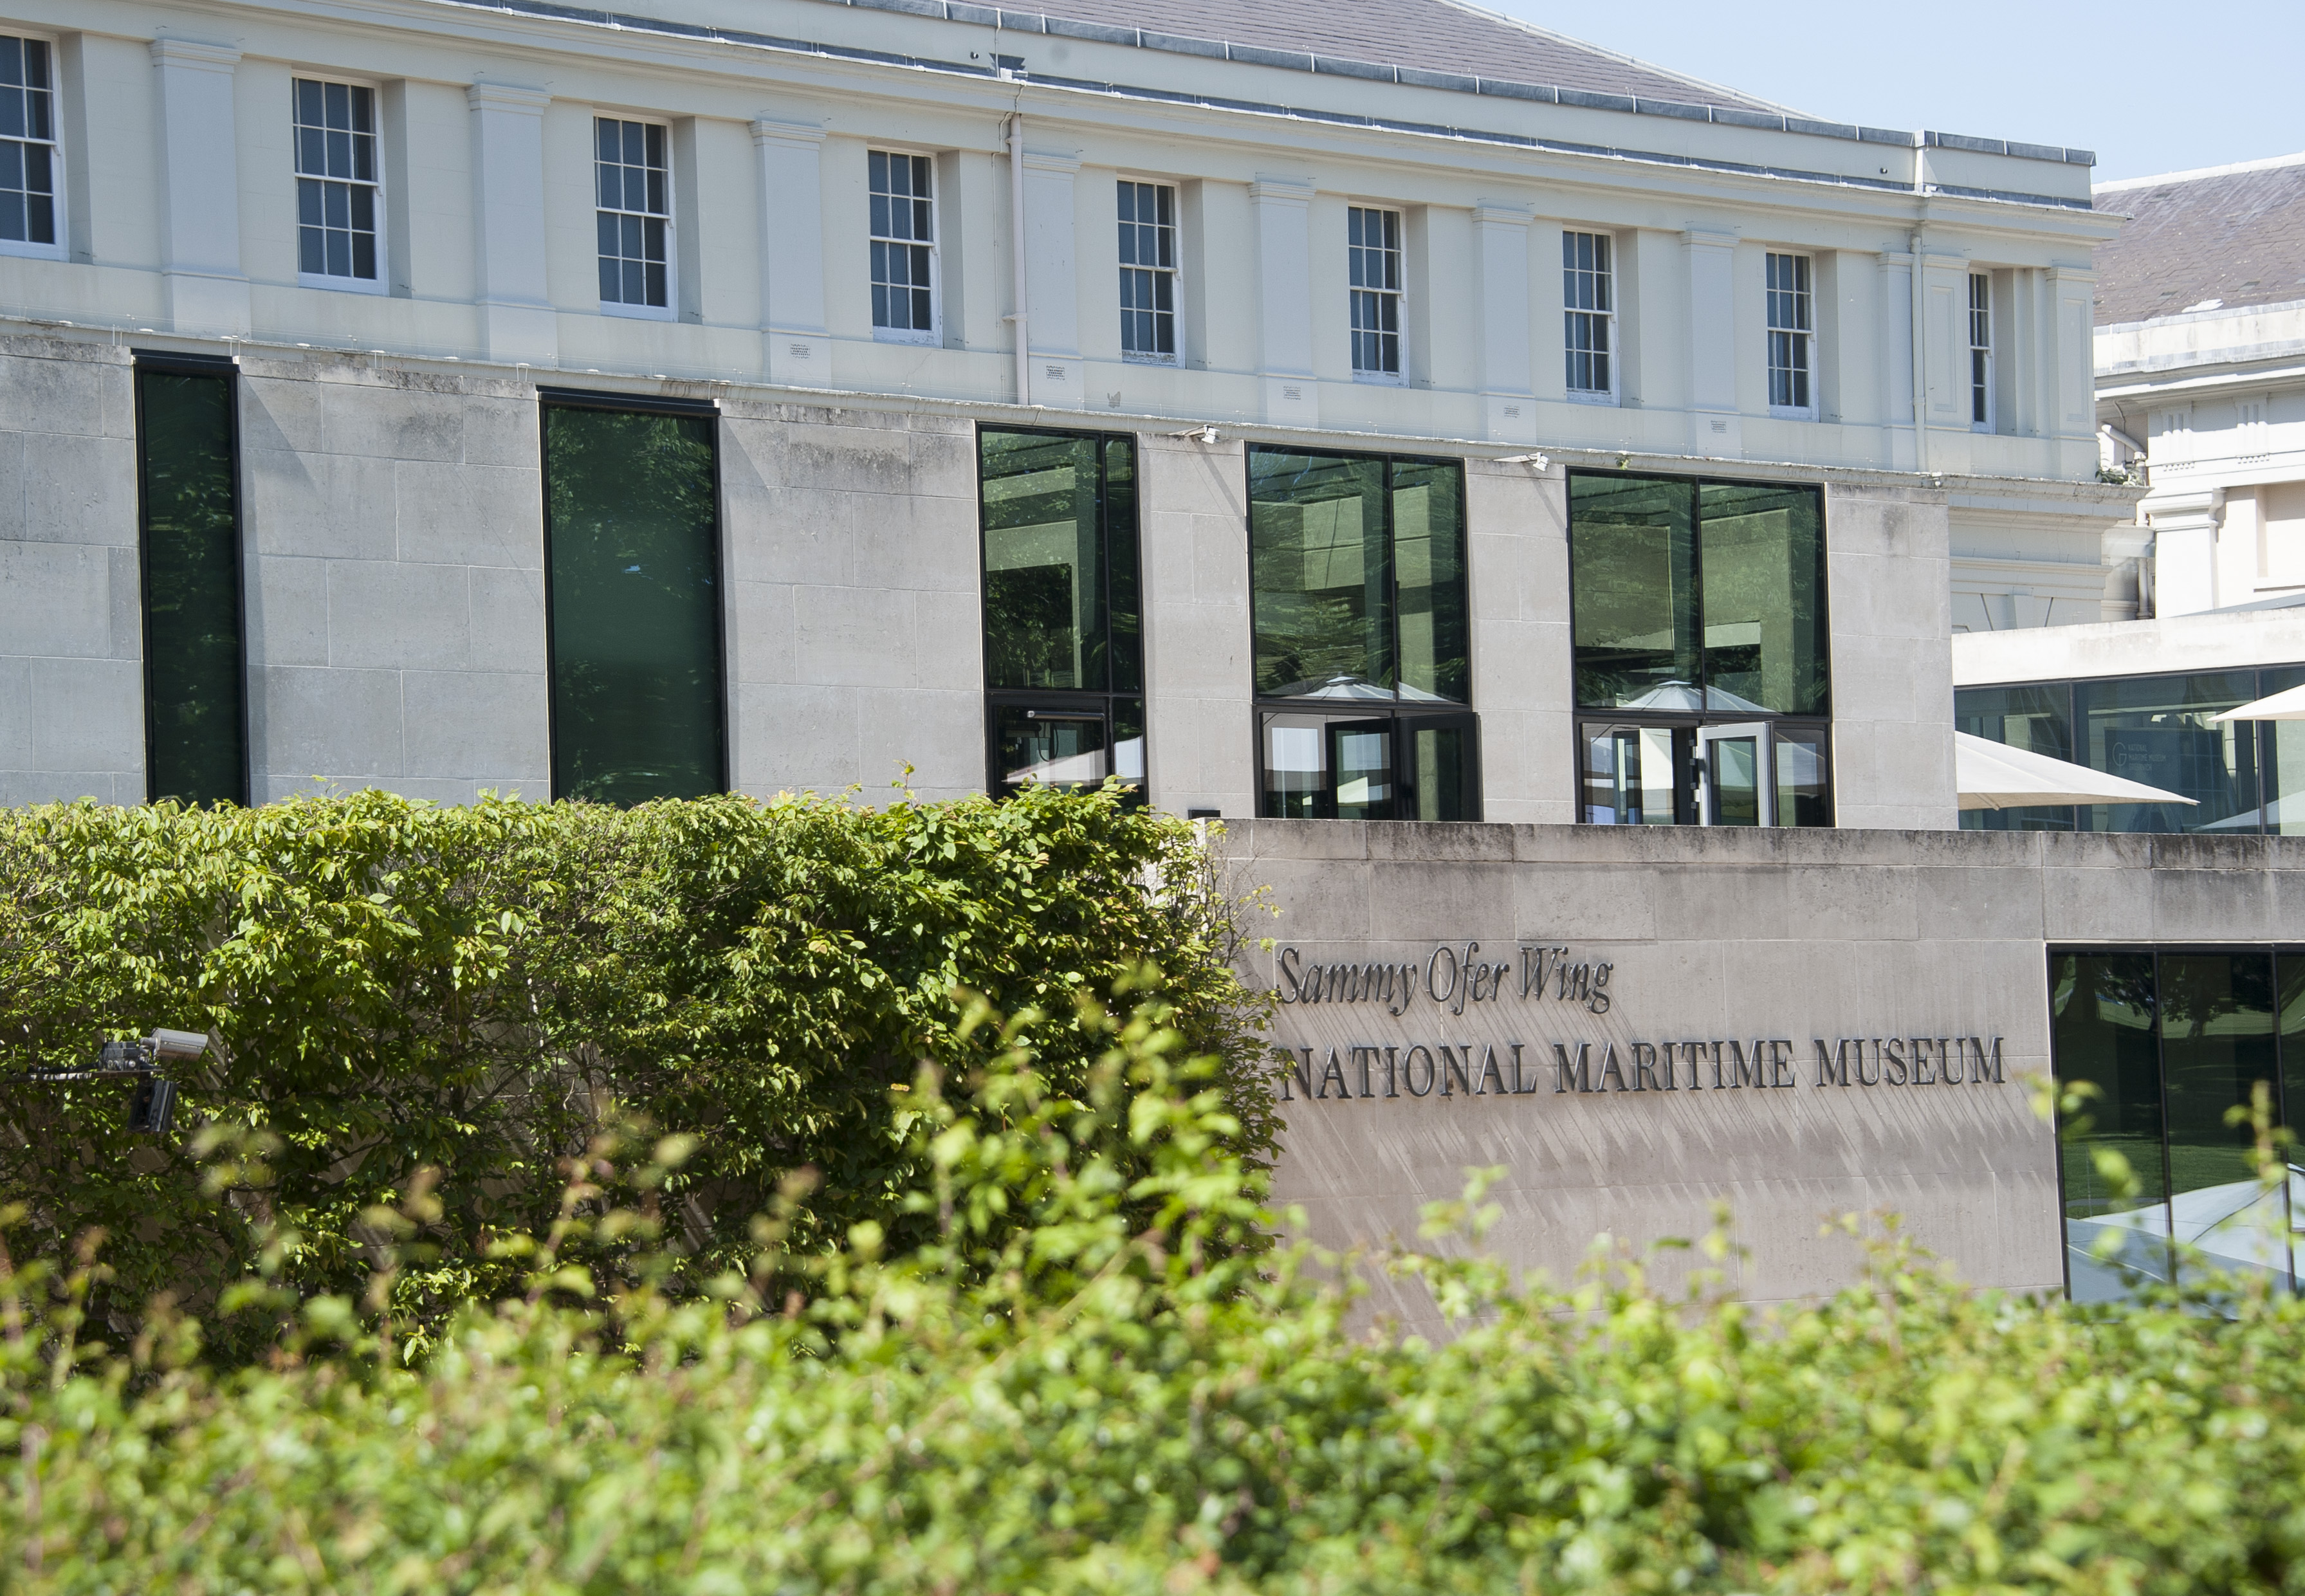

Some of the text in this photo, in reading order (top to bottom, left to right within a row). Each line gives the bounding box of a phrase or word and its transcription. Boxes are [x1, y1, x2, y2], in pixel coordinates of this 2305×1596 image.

[1278, 942, 1613, 1016] Sammy Ofer Wing
[1281, 1036, 2006, 1101] NATIONAL MARITIME MUSEUM
